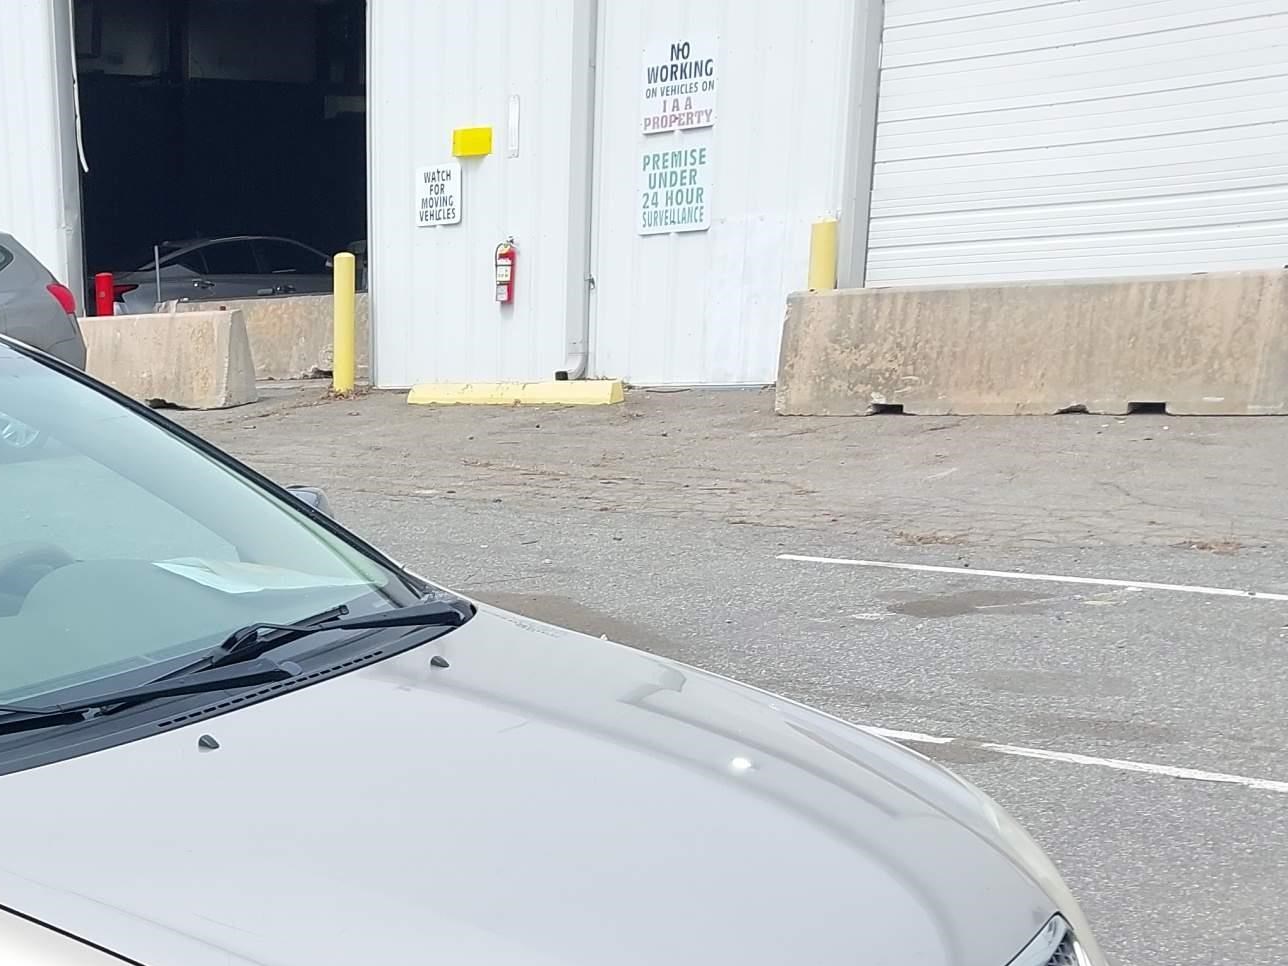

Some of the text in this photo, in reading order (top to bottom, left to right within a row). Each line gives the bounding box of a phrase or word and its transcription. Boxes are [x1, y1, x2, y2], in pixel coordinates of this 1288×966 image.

[670, 41, 690, 62] NO
[647, 58, 713, 84] WORKING
[645, 79, 715, 99] ON VEHICLES ON
[643, 108, 713, 131] PROPERTY
[642, 147, 707, 171] PREMISE
[423, 168, 452, 184] WATCH
[648, 168, 698, 190] UNDER
[429, 183, 445, 196] FOR
[642, 187, 704, 209] 24 HOUR
[421, 194, 454, 210] MOVING
[419, 207, 456, 222] VEHICLES
[642, 205, 705, 228] SURVEILLANCE
